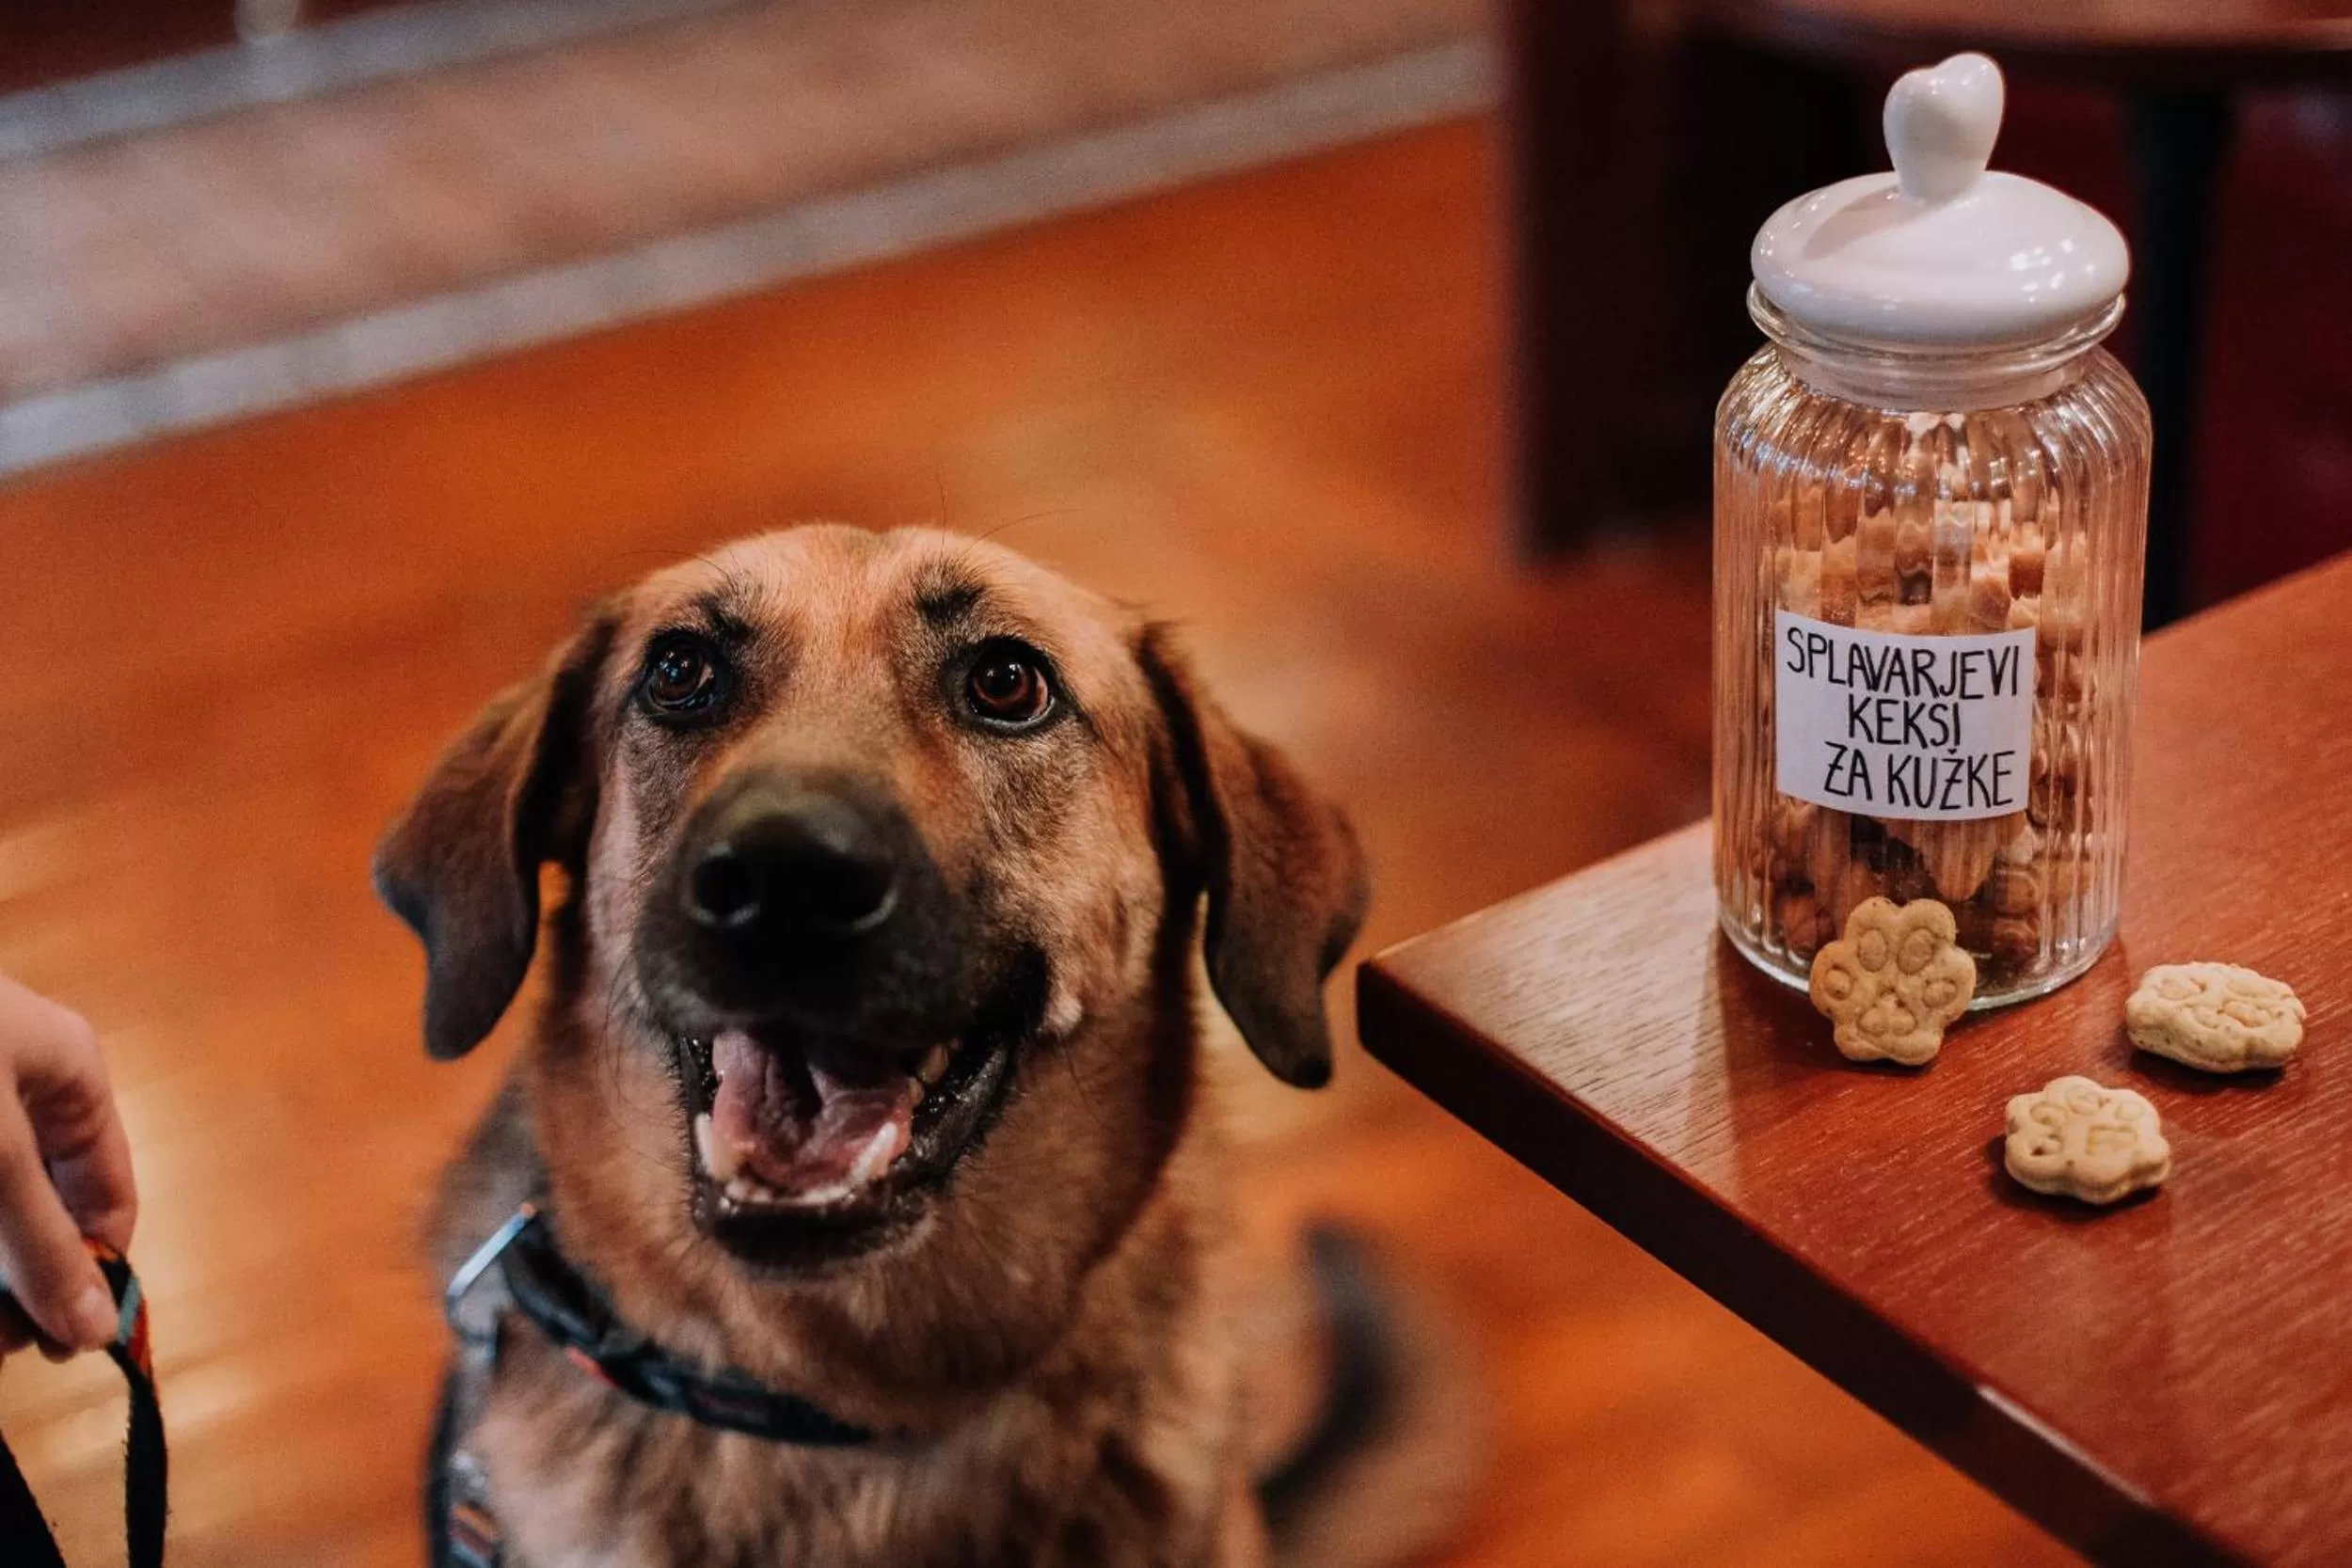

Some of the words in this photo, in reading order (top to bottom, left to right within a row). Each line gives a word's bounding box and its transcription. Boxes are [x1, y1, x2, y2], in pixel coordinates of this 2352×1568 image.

[1786, 626, 2020, 700] SPLAVARJEVI
[1848, 693, 1962, 749] KEKSI
[1823, 741, 1873, 801] ZA
[1887, 749, 2016, 811] KUŽKE
